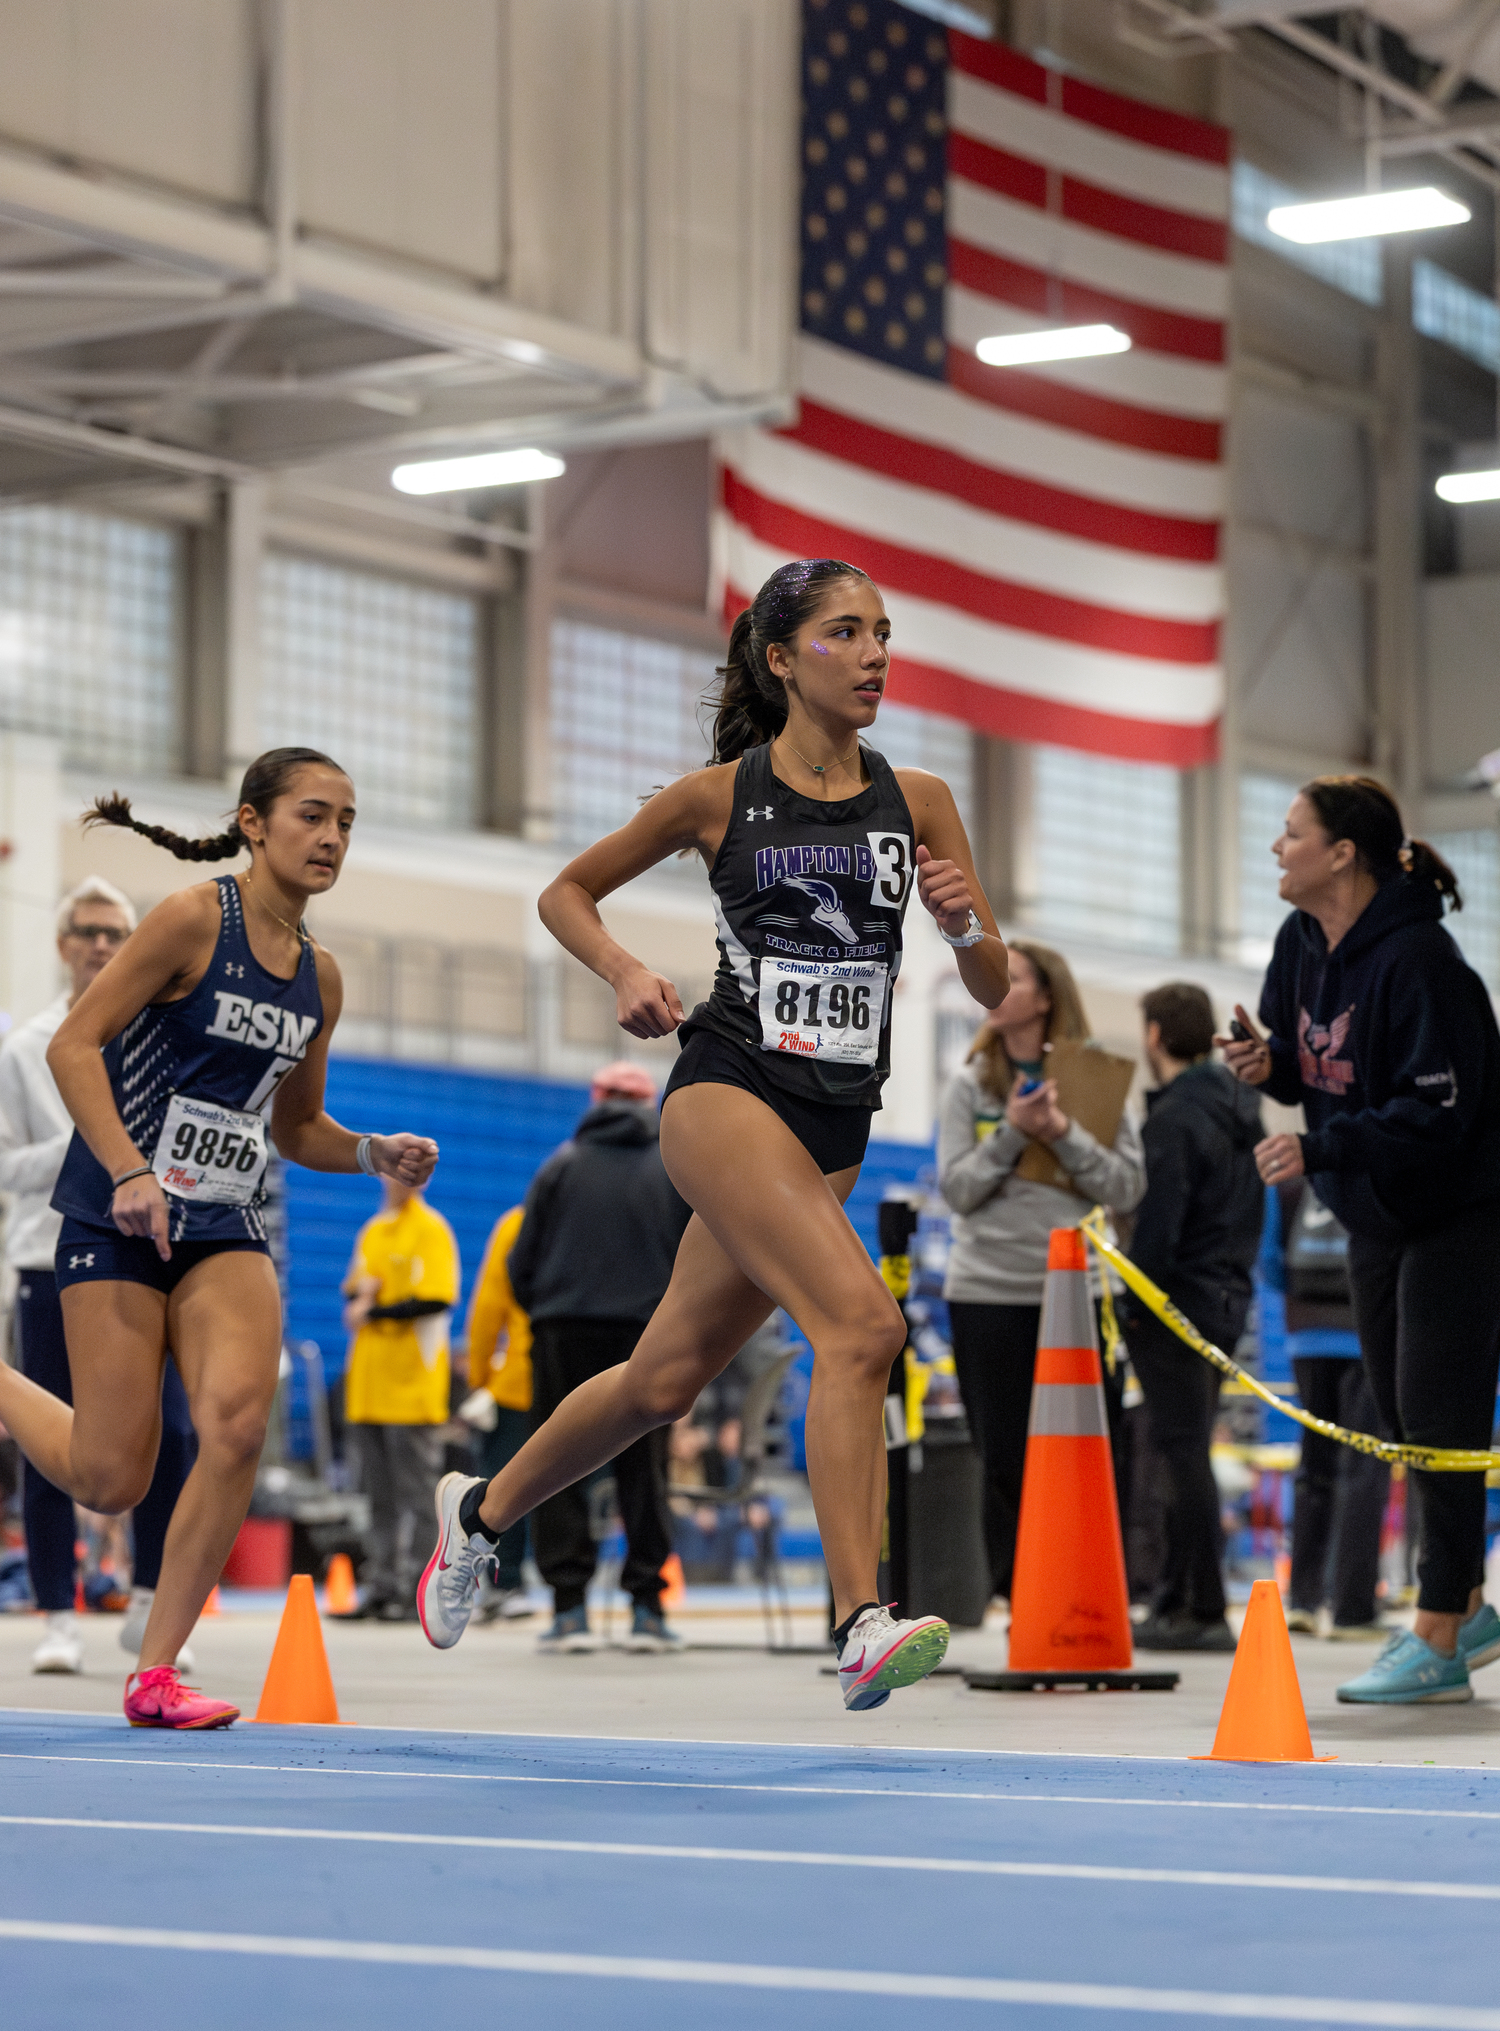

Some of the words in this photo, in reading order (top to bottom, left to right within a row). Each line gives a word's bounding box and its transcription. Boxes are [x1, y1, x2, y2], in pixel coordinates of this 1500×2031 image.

[756, 845, 850, 893] HAMPTON
[878, 837, 906, 903] 3
[765, 933, 825, 957] TRACK
[827, 946, 839, 958] &
[844, 942, 886, 958] FIELD
[776, 961, 829, 975] Schwab's
[831, 964, 852, 977] 2nd
[852, 966, 876, 978] Wind
[775, 980, 871, 1030] 8196
[204, 990, 317, 1059] ESM
[778, 1031, 800, 1050] 2nd
[789, 1040, 816, 1052] WIND
[183, 1104, 226, 1123] Schwab's
[171, 1122, 258, 1172] 9856
